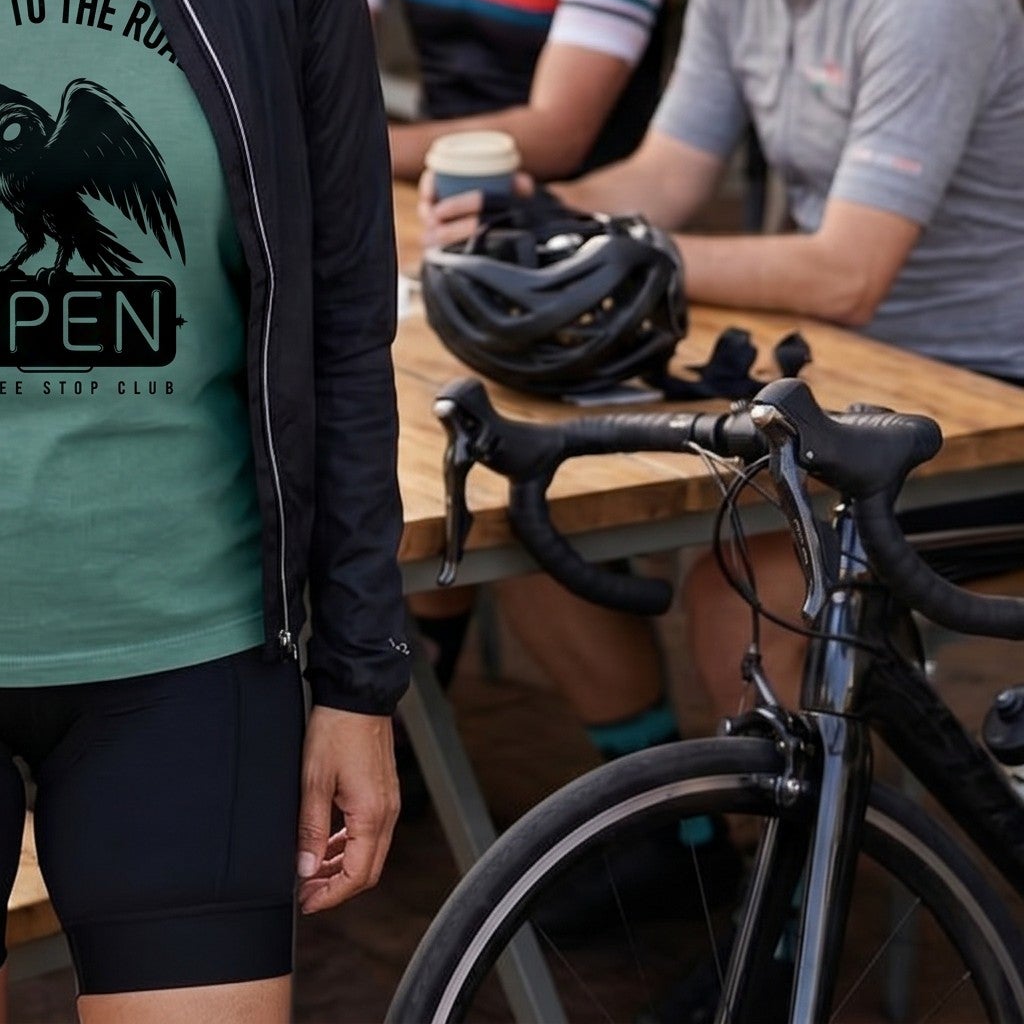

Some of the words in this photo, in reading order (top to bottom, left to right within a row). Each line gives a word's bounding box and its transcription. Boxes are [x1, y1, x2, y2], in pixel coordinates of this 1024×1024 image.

[122, 0, 184, 72] RO
[43, 380, 99, 395] STOP
[118, 380, 174, 395] CLUB
